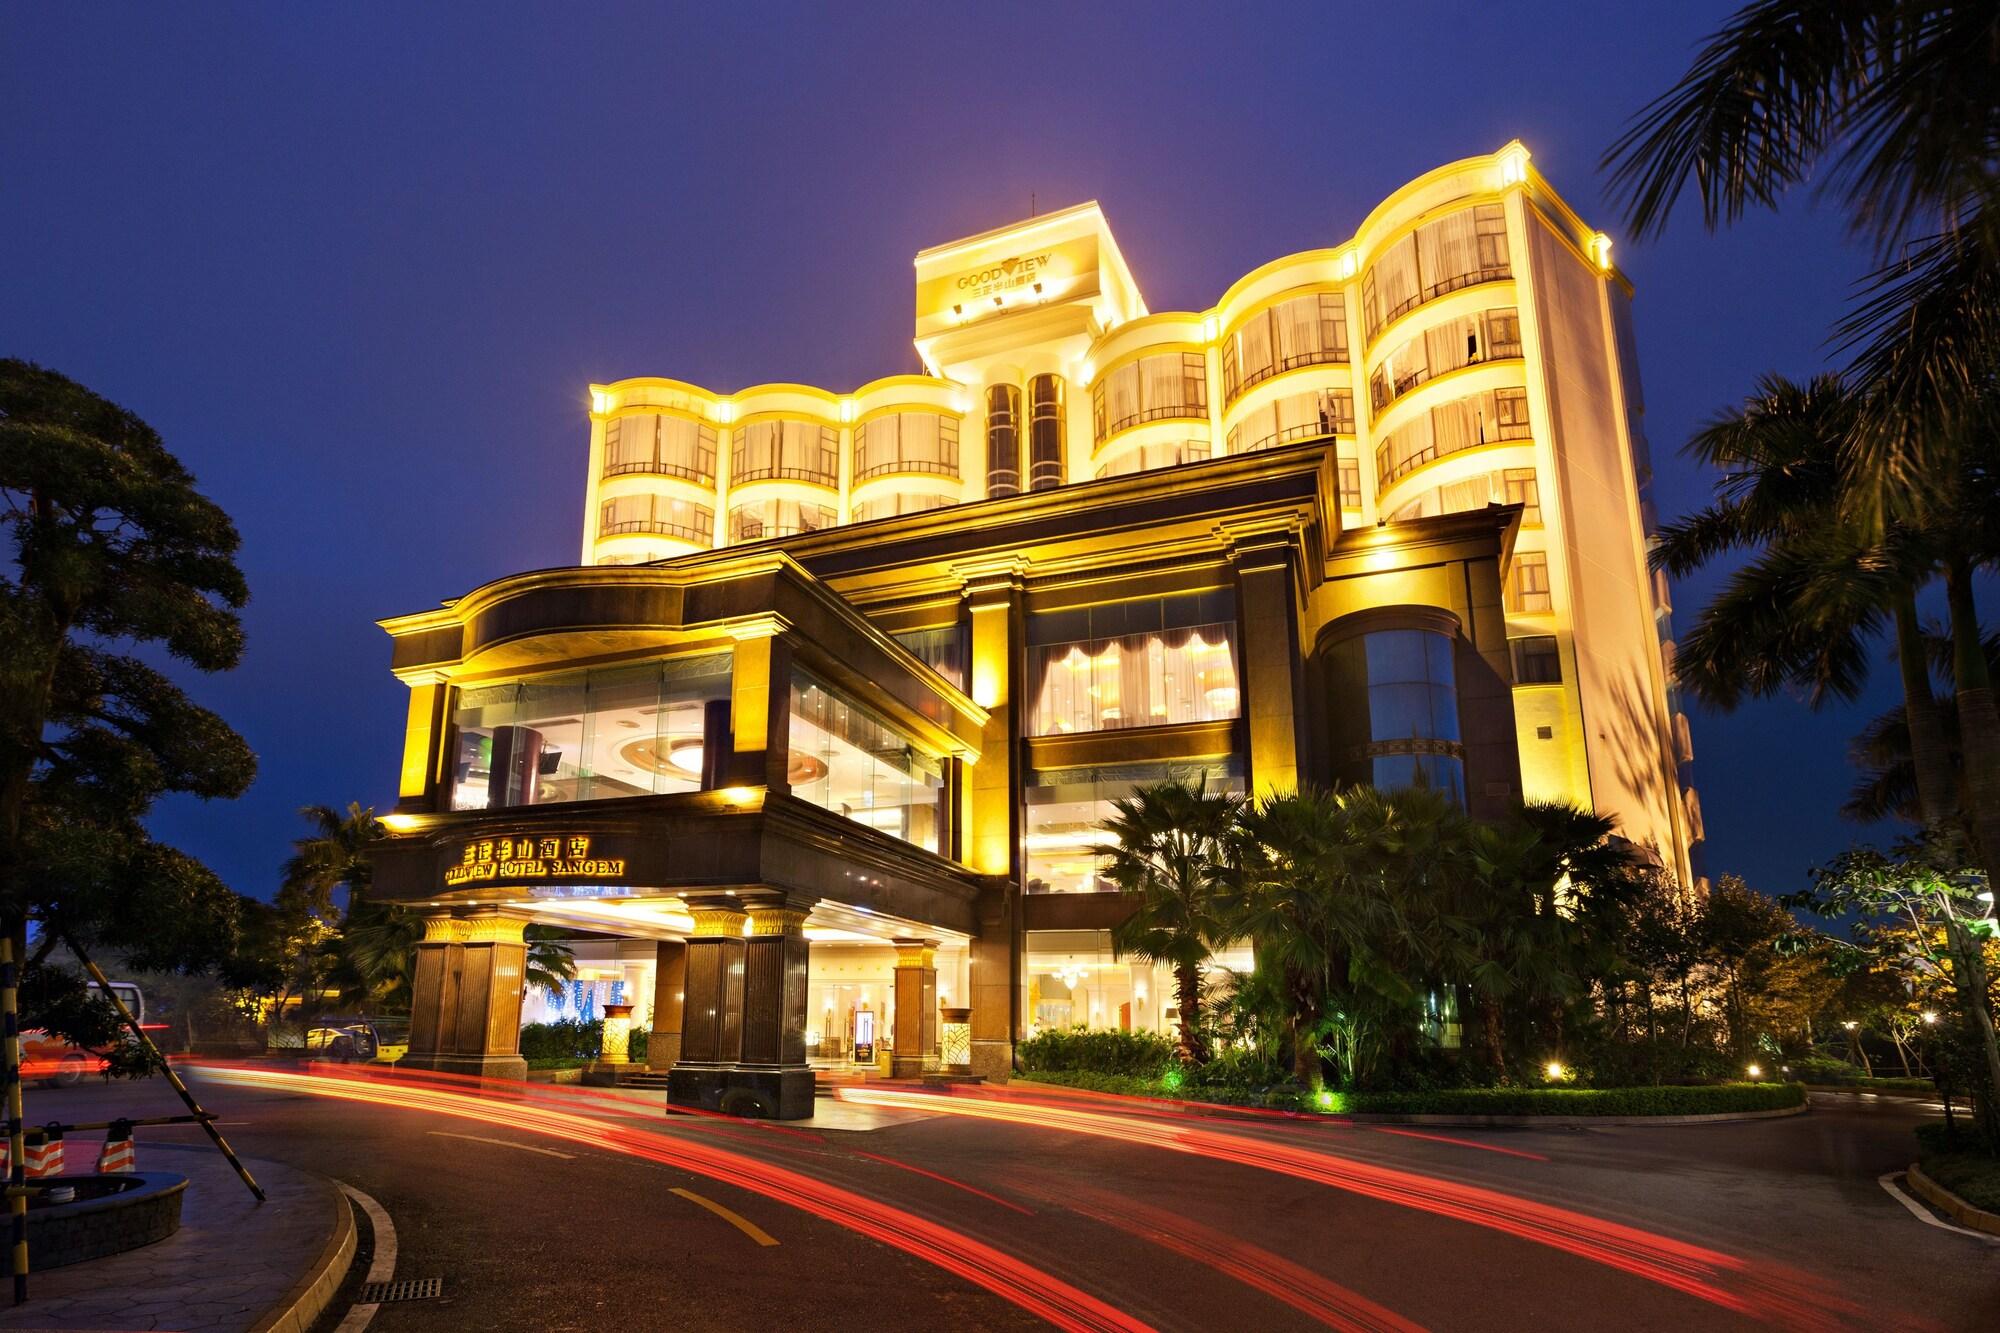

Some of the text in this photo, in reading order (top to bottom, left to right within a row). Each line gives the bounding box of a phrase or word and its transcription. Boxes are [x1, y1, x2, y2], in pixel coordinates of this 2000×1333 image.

[462, 837, 590, 866] 三正半山酒店
[499, 860, 547, 877] HOTEL
[551, 860, 625, 876] SANGEM
